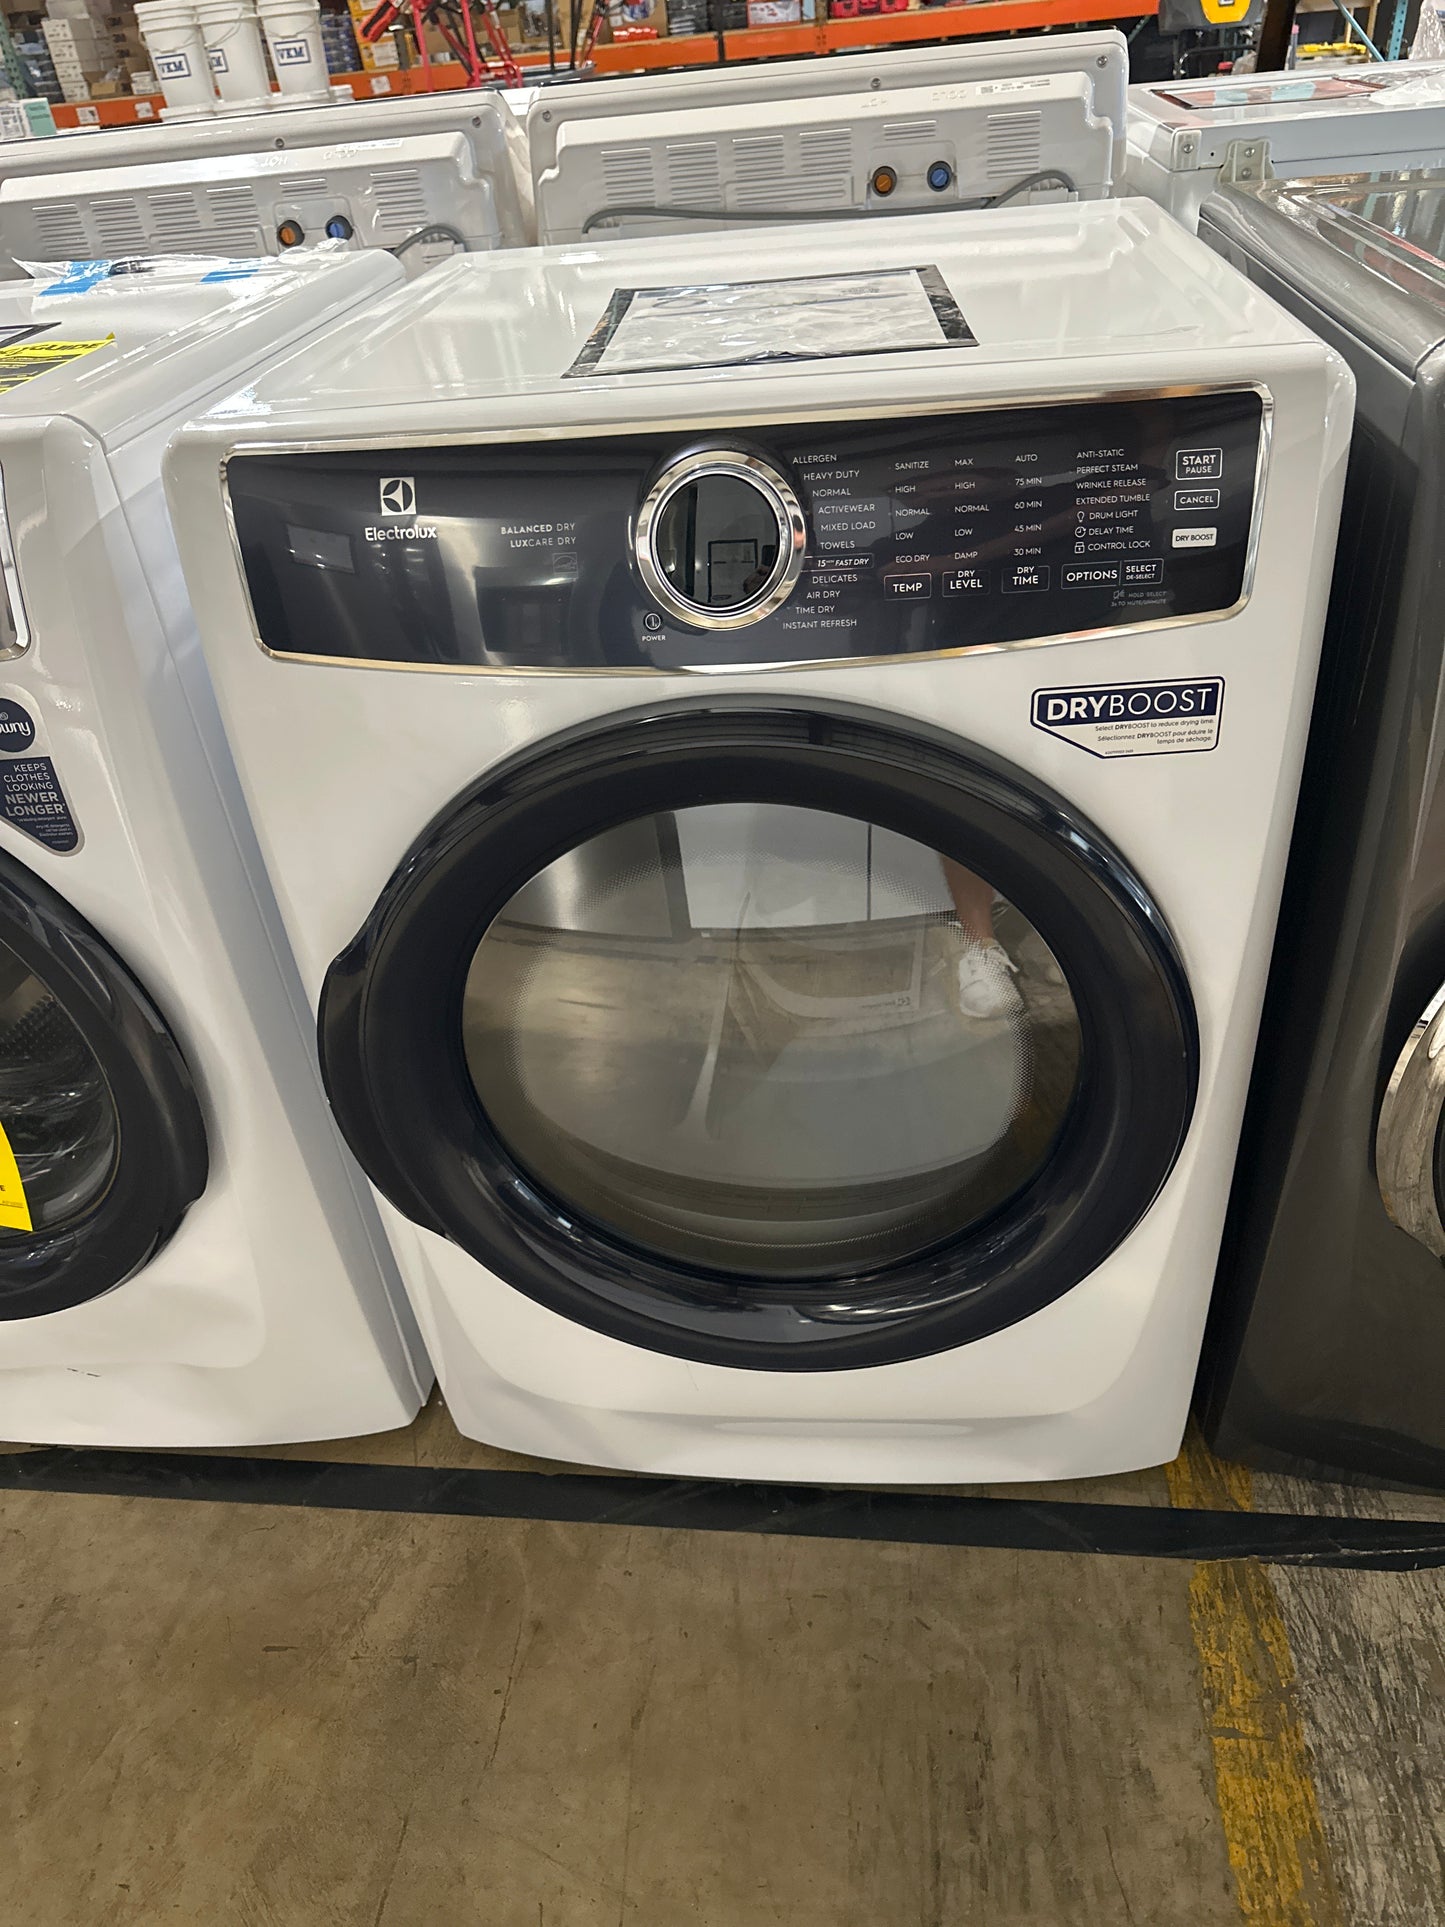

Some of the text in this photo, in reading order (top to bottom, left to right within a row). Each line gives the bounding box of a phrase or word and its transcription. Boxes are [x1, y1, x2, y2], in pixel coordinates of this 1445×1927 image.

[1015, 454, 1038, 462] AUTO
[1077, 449, 1124, 458] ANTI-STATIC
[793, 454, 837, 464] ALLERGEN
[954, 458, 974, 467] MAX
[1182, 455, 1216, 466] START
[895, 461, 929, 470] SANITIZE
[1076, 464, 1138, 474] PERFECT STEAM
[1186, 466, 1212, 474] PAUSE
[804, 470, 859, 480] HEAVY DUTY
[954, 482, 976, 490] HIGH
[1015, 477, 1042, 486] 75 MIN
[1076, 479, 1146, 489] WRINKLE RELEASE
[813, 488, 851, 497] NORMAL
[1076, 494, 1150, 505] EXTENDED TUMBLE
[1180, 495, 1214, 504] CANCEL
[818, 504, 875, 514] ACTIVEWEAR
[954, 504, 990, 513] NORMAL
[1015, 500, 1042, 509] 60 MIN
[895, 508, 931, 517] NORMAL
[1089, 510, 1138, 520] DRUM LIGHT
[501, 523, 576, 535] BALANCED DRY
[821, 521, 876, 531] MIXED LOAD
[1014, 524, 1042, 533] 45 MIN
[364, 525, 438, 542] Electrolux
[954, 528, 973, 537] LOW
[1088, 526, 1134, 536] DELAY TIME
[895, 532, 914, 541] LOW
[1175, 533, 1214, 542] DRY BOOST
[510, 537, 577, 548] LUXCARE DRY
[820, 541, 855, 550] TOWELS
[1087, 541, 1150, 551] CONTROL LOCK
[954, 551, 978, 560] DAMP
[1013, 547, 1042, 556] 30 MIN
[853, 558, 870, 566] DRY
[895, 554, 931, 563] ECO DRY
[1017, 566, 1035, 574] DRY
[1126, 564, 1156, 573] SELECT
[957, 569, 976, 578] DRY
[1066, 570, 1118, 582] OPTIONS
[812, 574, 858, 584] DELICATES
[1012, 575, 1039, 585] TIME
[893, 582, 923, 593] TEMP
[950, 579, 983, 590] LEVEL
[807, 590, 841, 599] AIR DRY
[796, 605, 835, 614] TIME DRY
[783, 619, 857, 630] INSTANT REFRESH
[1047, 688, 1213, 721] DRYBOOST
[1115, 722, 1149, 730] DRYBOOST
[1180, 719, 1199, 727] drying
[1137, 731, 1171, 739] DRYBOOST
[13, 763, 47, 772] KEEPS
[3, 772, 51, 783] CLOTHES
[6, 782, 54, 792] LOOKING
[5, 791, 59, 805] NEWER
